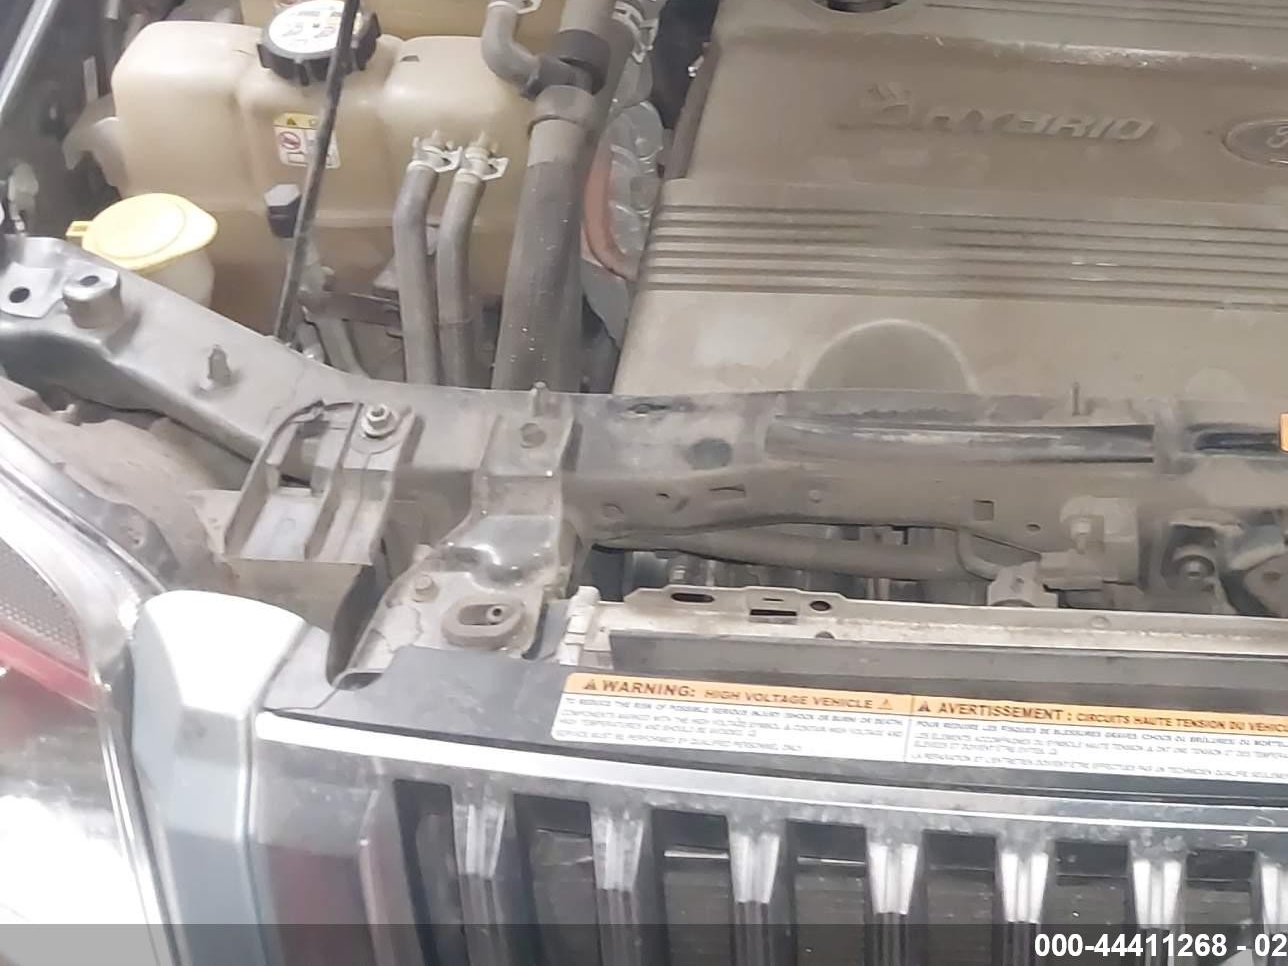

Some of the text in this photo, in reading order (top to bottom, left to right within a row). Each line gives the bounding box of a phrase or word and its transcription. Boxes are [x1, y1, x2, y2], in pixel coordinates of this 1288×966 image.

[601, 679, 873, 709] WARNING: HIGH VOLTAGE VEHICLE
[1076, 712, 1130, 724] CIRCUITS
[1135, 715, 1172, 727] HAUTE
[1176, 718, 1225, 730] TENSION
